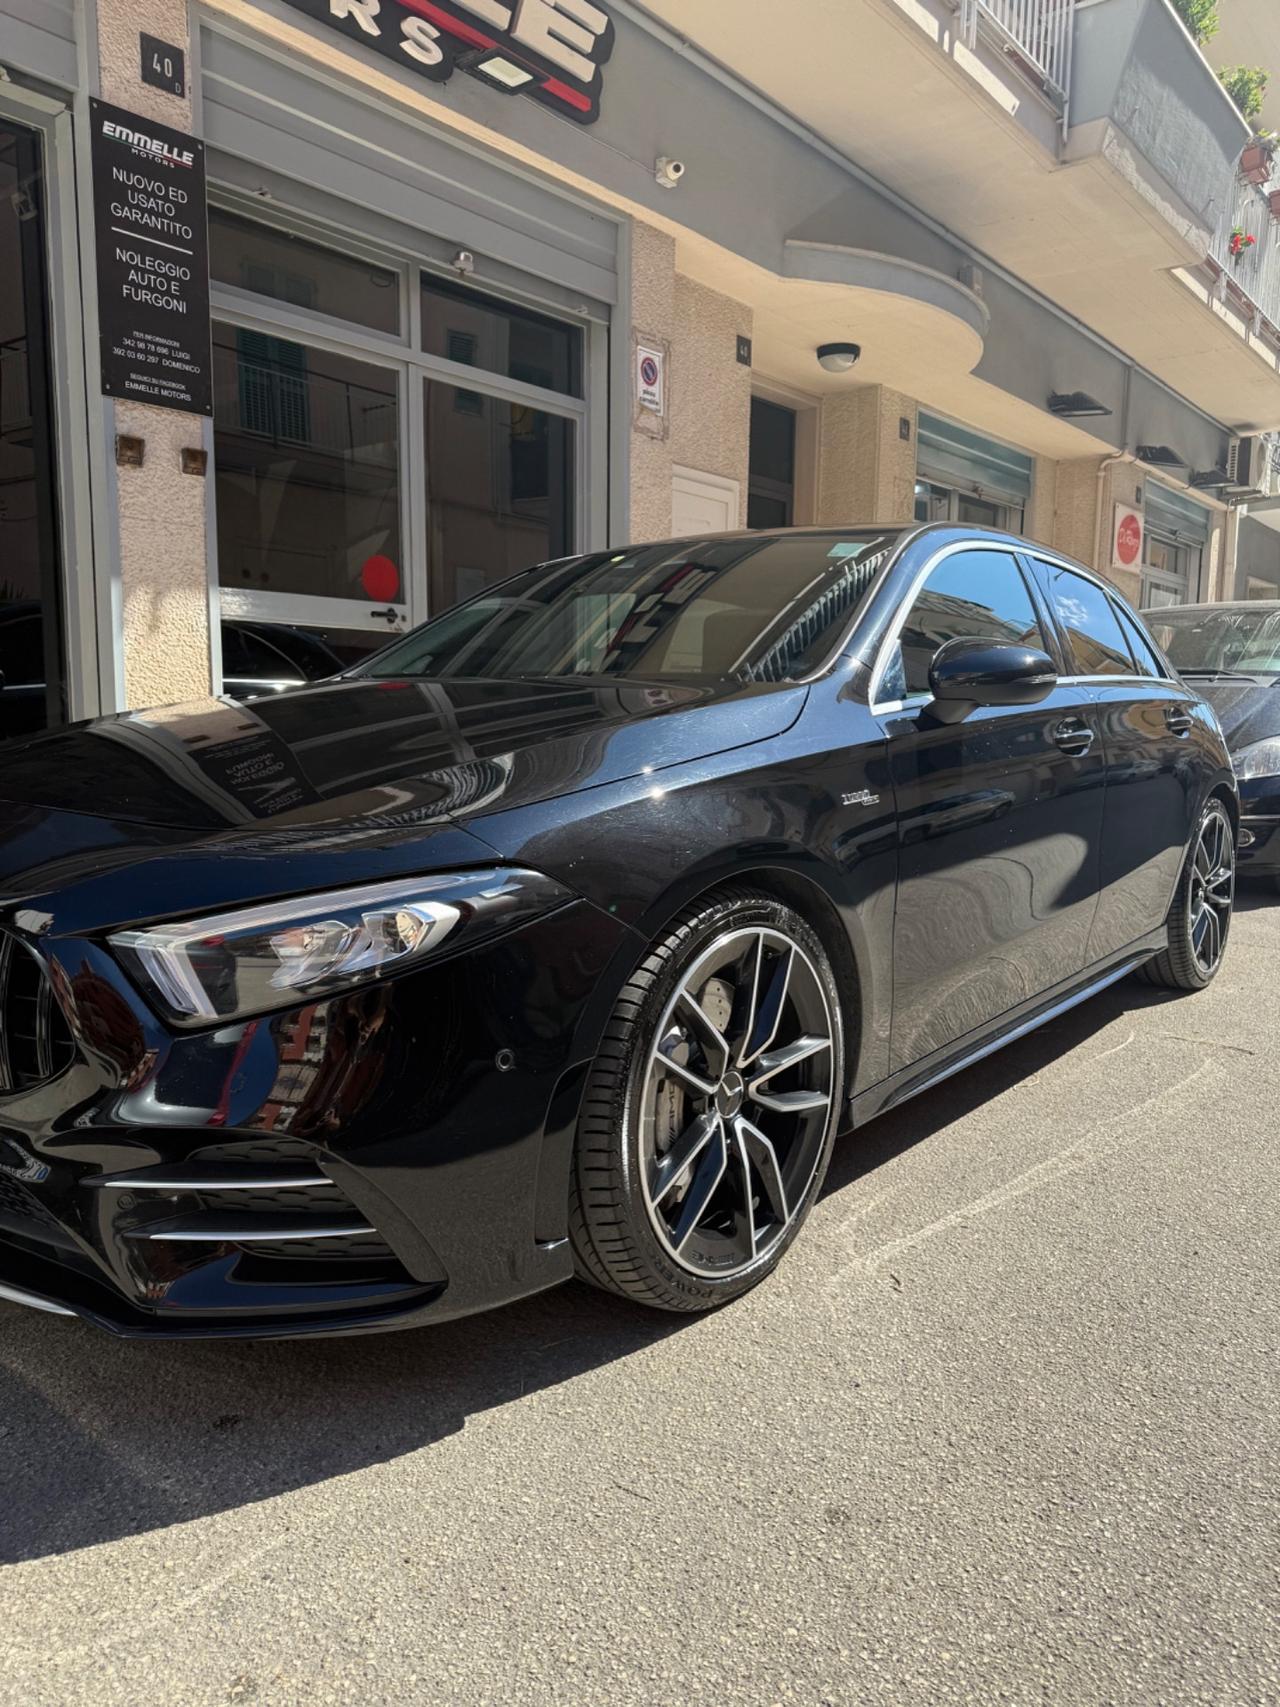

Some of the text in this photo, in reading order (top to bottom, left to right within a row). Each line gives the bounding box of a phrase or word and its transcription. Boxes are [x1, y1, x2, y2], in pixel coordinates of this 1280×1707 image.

[152, 53, 173, 77] 40
[102, 120, 195, 166] EMMELLE
[131, 148, 175, 168] MOTORS
[112, 166, 188, 204] NUOVO ED
[128, 189, 176, 217] USATO
[110, 202, 192, 239] GARANTITO
[116, 247, 191, 281] NOLEGGIO
[128, 269, 181, 296] AUTO E
[122, 284, 187, 314] FURGONI
[123, 337, 135, 346] 342
[172, 349, 190, 360] LUIGI
[162, 358, 200, 373] DOMENICO
[125, 381, 191, 401] EMMELLE MOTORS
